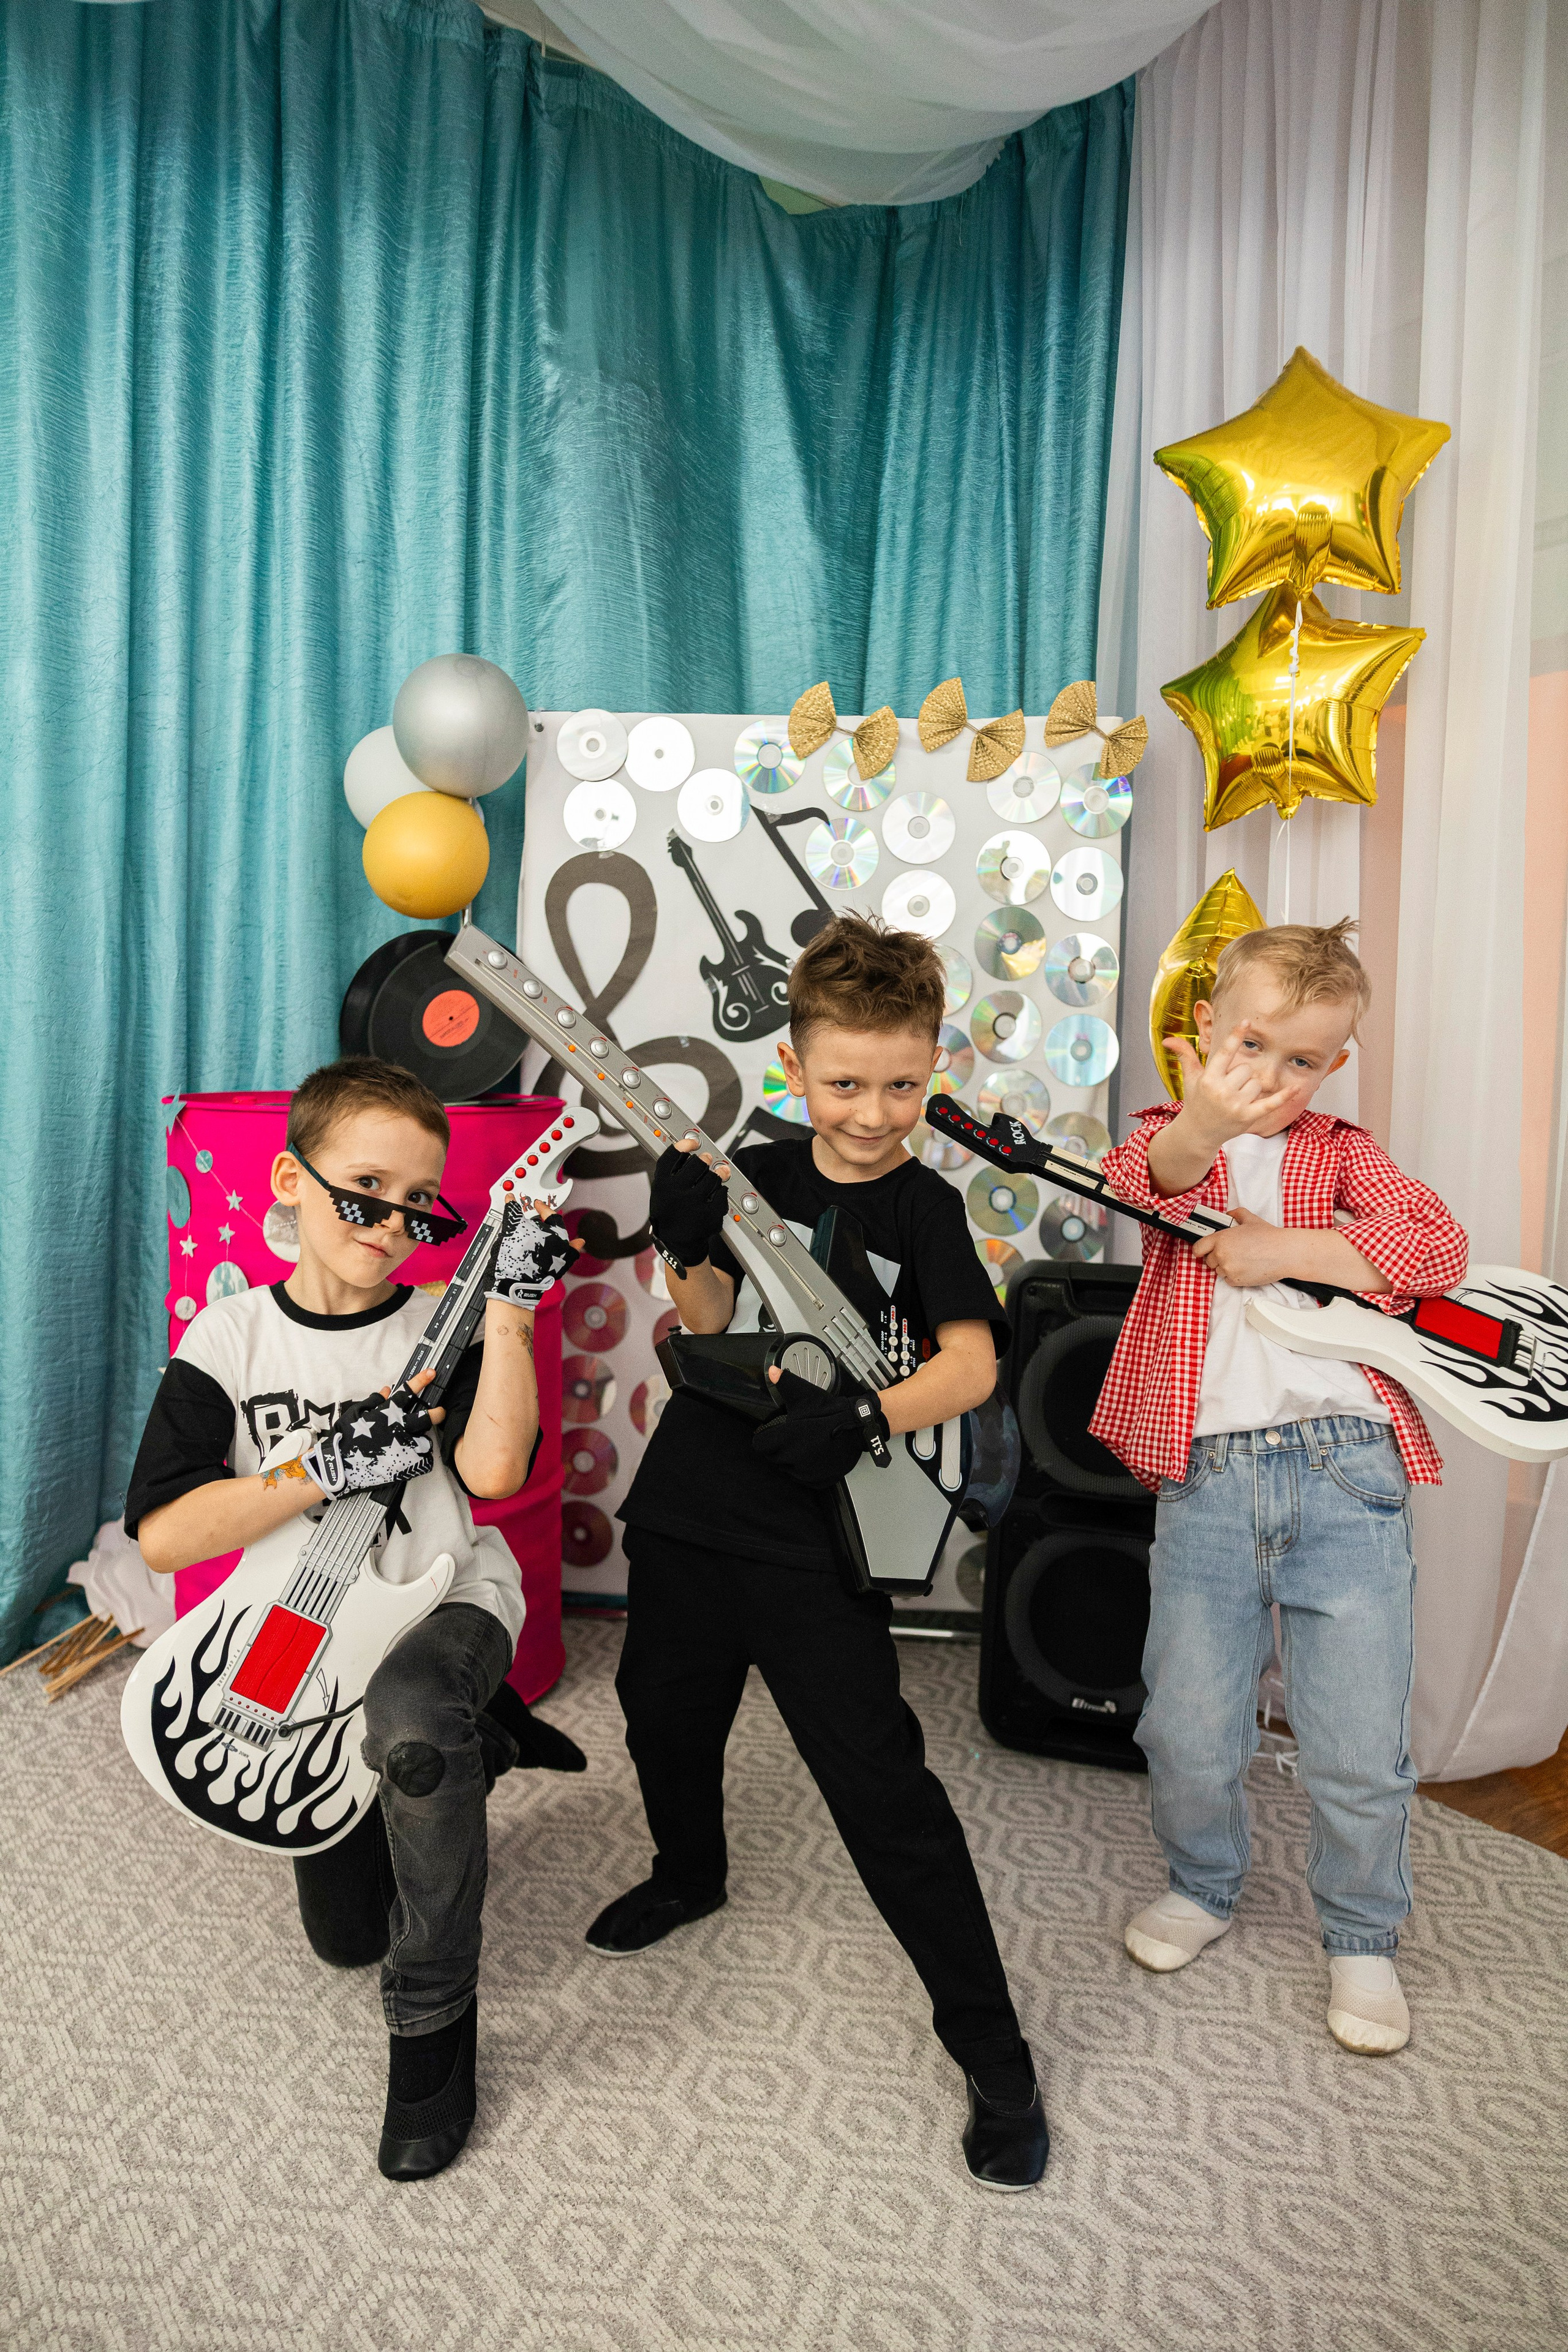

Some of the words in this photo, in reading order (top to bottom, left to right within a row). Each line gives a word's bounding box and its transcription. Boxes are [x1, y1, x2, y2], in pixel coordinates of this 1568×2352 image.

[1009, 1121, 1026, 1145] ROCK
[519, 1192, 557, 1213] RK
[473, 1242, 482, 1256] VOLUME
[662, 1250, 677, 1269] 5.11
[870, 1435, 884, 1456] 5.11
[328, 1462, 337, 1482] RUSH
[217, 1672, 227, 1687] DRUM
